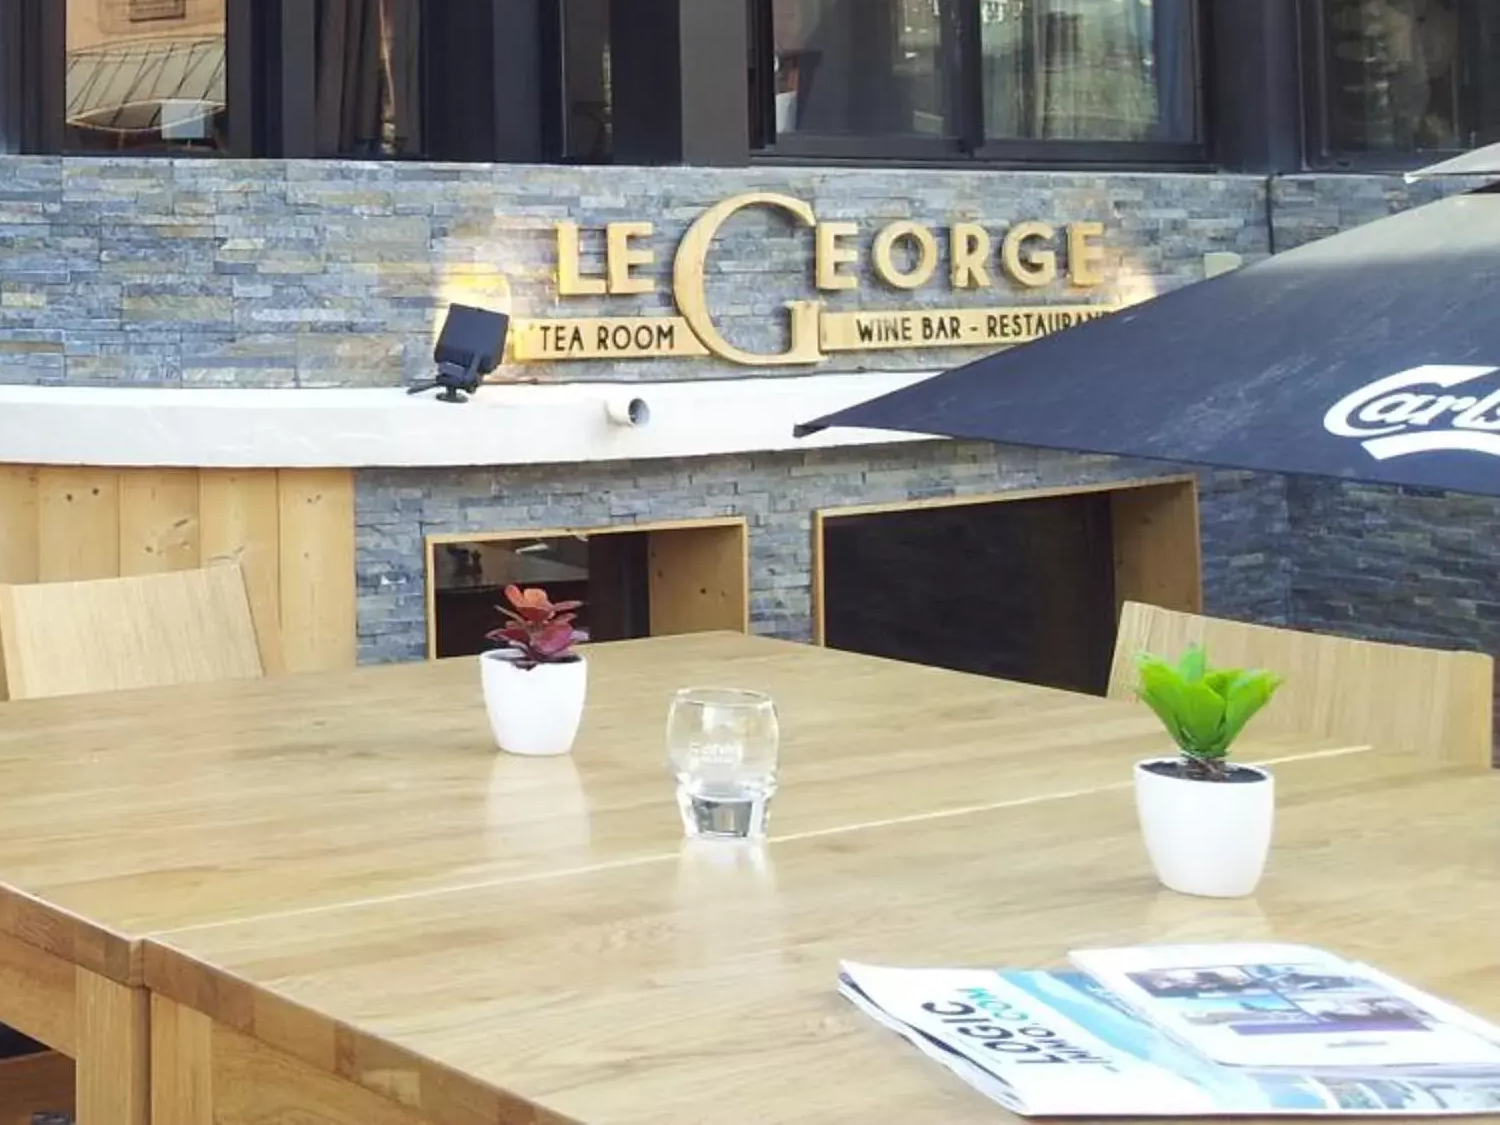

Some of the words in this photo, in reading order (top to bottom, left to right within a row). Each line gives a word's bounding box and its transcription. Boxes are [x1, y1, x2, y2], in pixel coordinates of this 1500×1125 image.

[555, 221, 655, 295] LE
[673, 192, 1106, 365] GEORGE
[540, 326, 585, 352] TEA
[597, 325, 675, 350] ROOM
[856, 318, 913, 344] WINE
[922, 316, 961, 340] BAR
[987, 310, 1114, 338] RESTAURA
[921, 1001, 1070, 1064] LOGIC
